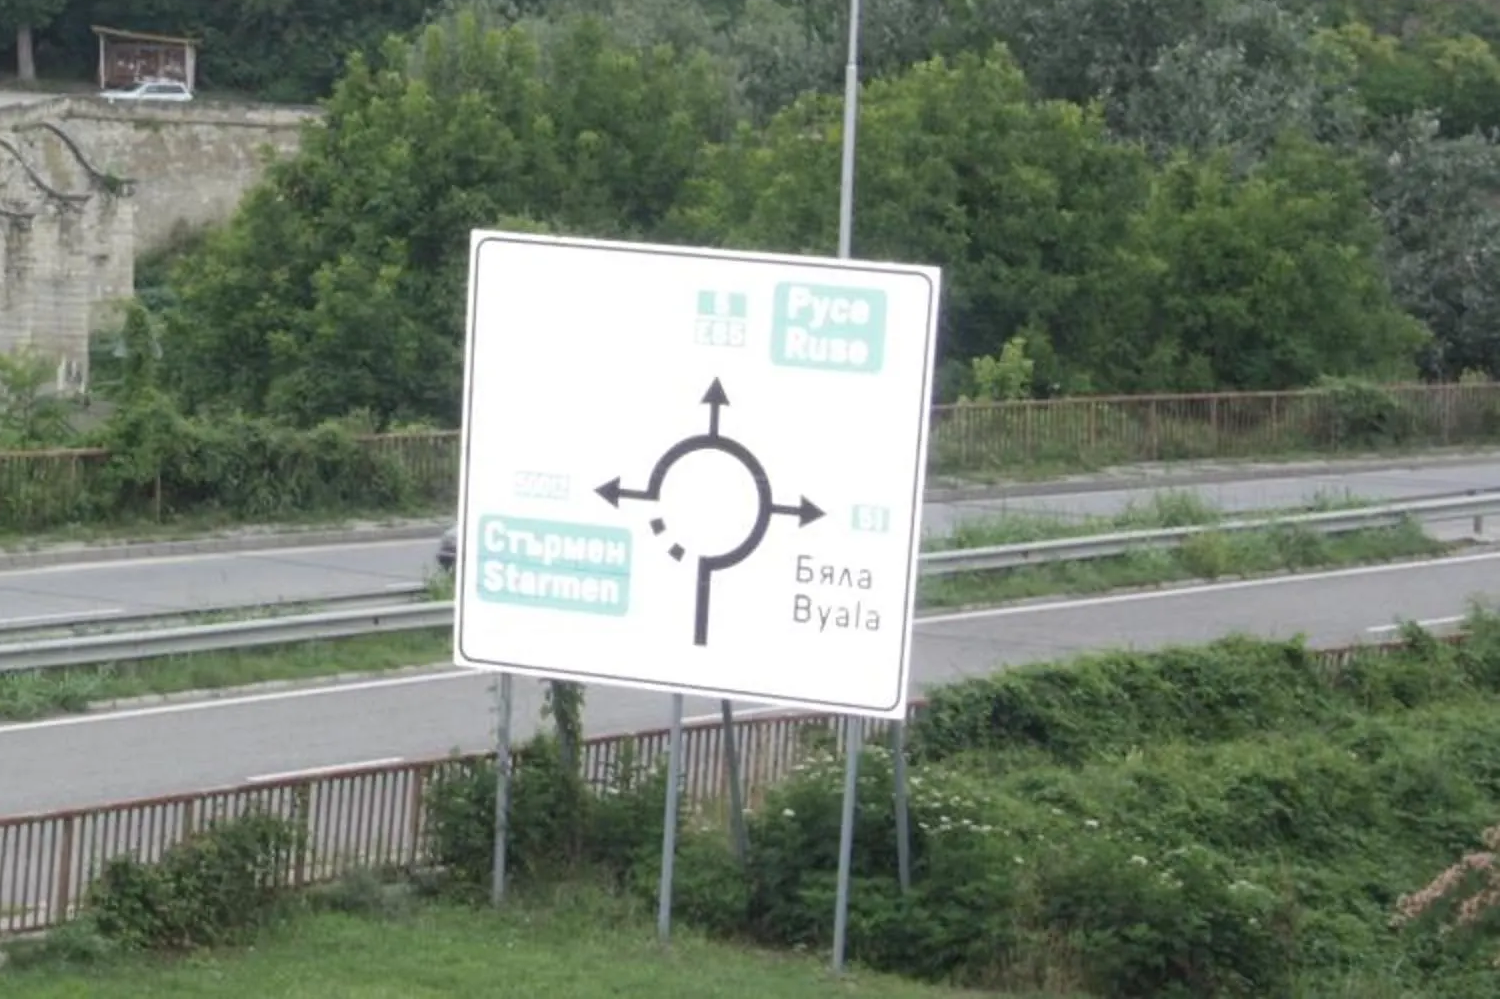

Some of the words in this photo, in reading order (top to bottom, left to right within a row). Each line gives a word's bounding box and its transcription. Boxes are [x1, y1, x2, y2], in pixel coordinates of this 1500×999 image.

[788, 287, 869, 329] Русе
[784, 326, 868, 365] Ruse
[485, 521, 625, 565] Стърмен
[483, 560, 618, 604] Starmen
[796, 555, 873, 590] Бяла
[793, 594, 880, 633] Byala
